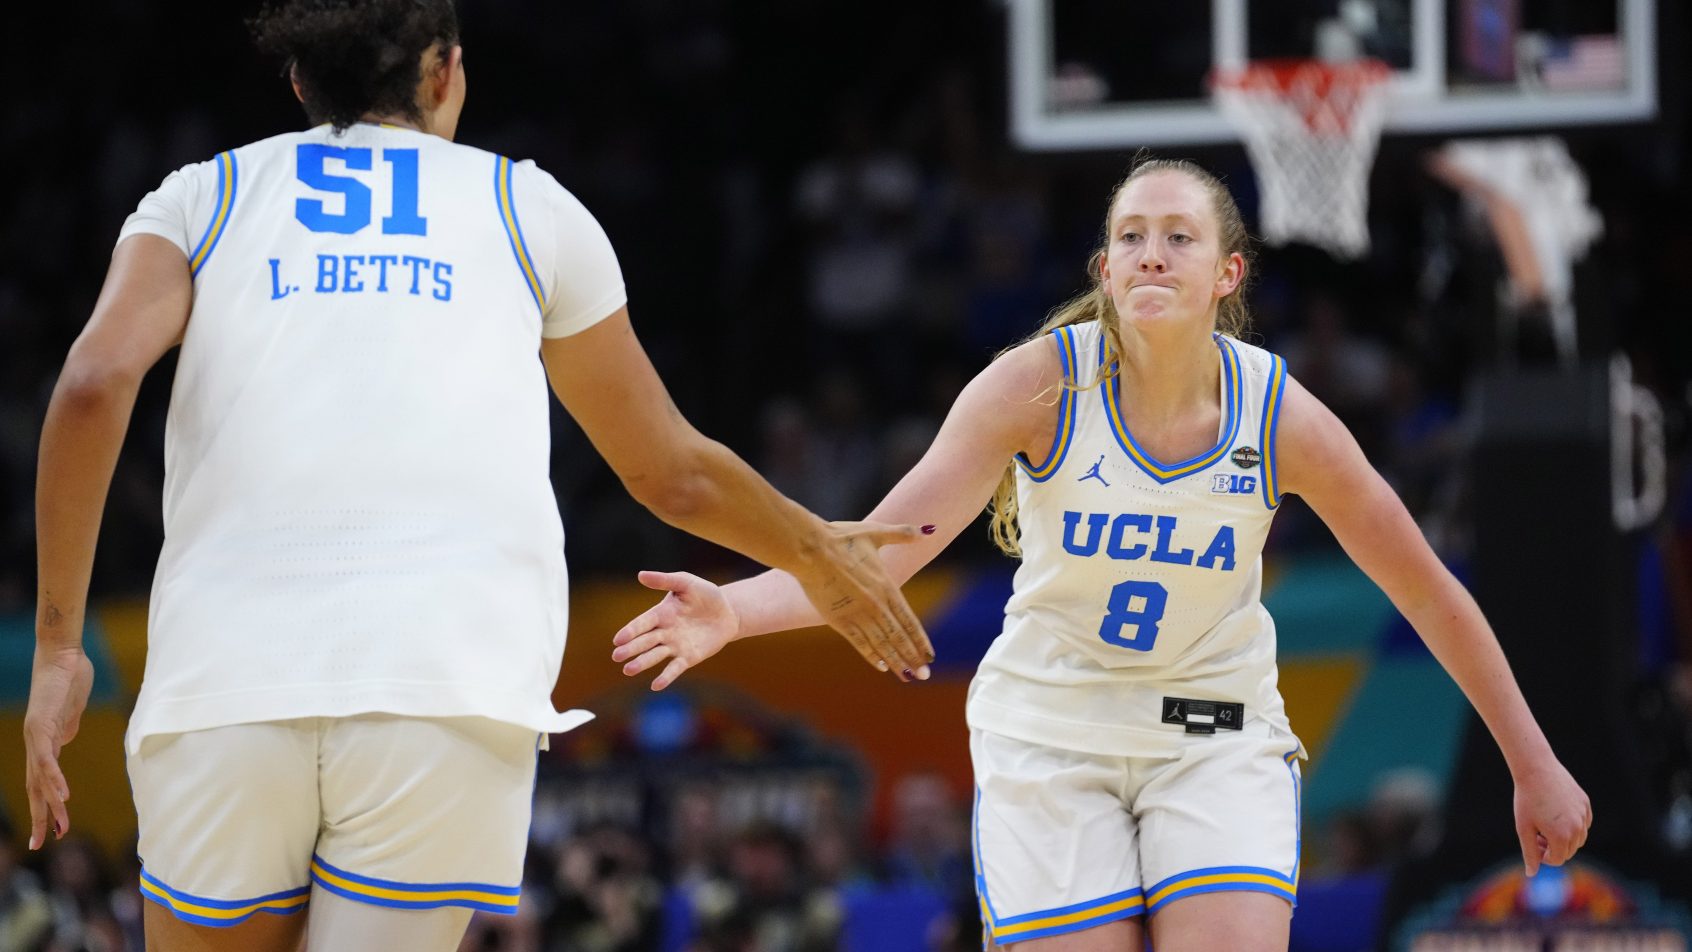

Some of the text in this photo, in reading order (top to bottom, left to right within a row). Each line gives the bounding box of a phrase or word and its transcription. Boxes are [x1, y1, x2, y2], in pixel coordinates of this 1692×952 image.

[295, 143, 427, 236] 51
[268, 254, 453, 301] L. BETTS
[1062, 510, 1236, 571] UCLA
[1098, 580, 1168, 652] 8
[1219, 710, 1232, 721] 42
